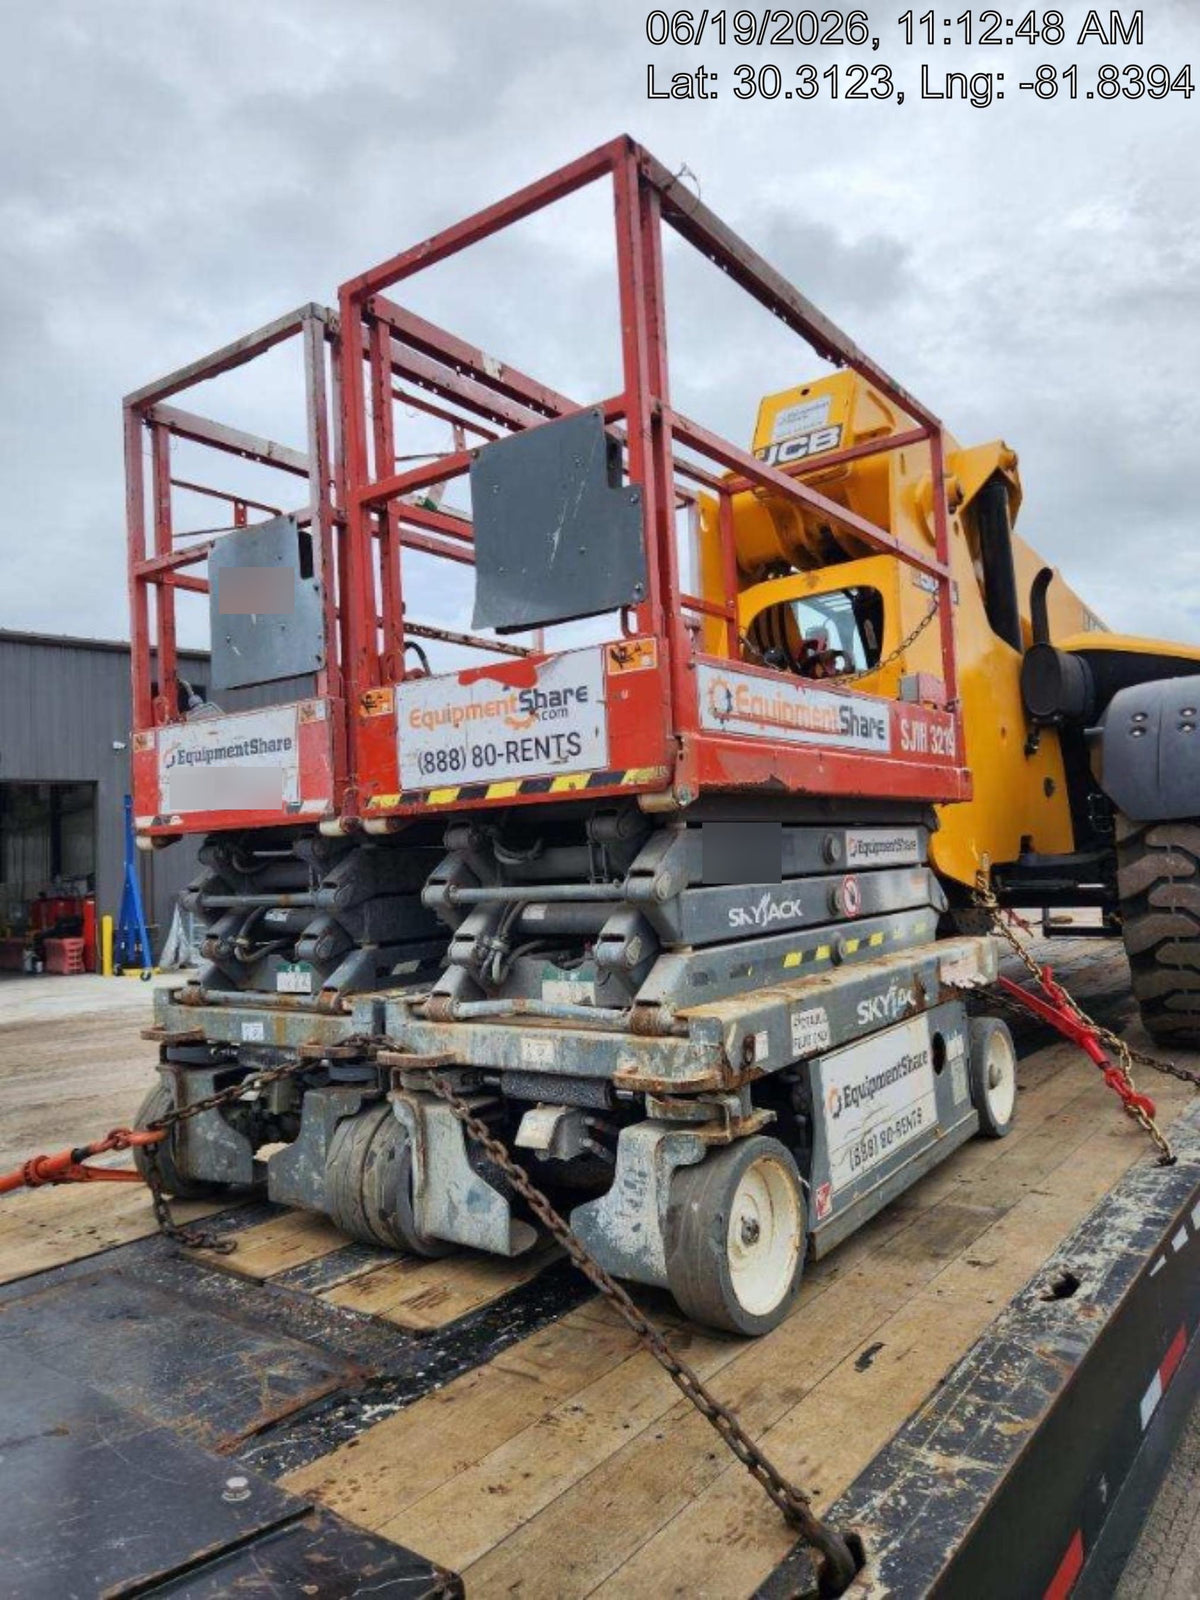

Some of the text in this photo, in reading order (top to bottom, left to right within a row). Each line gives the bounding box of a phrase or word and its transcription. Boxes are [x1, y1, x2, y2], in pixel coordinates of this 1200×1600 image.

[764, 425, 842, 466] JCB
[409, 685, 588, 730] EquipmentShare
[177, 737, 292, 765] EquipmentShare
[417, 731, 582, 776] (888) 80-RENTS
[728, 892, 803, 928] SKYJACK
